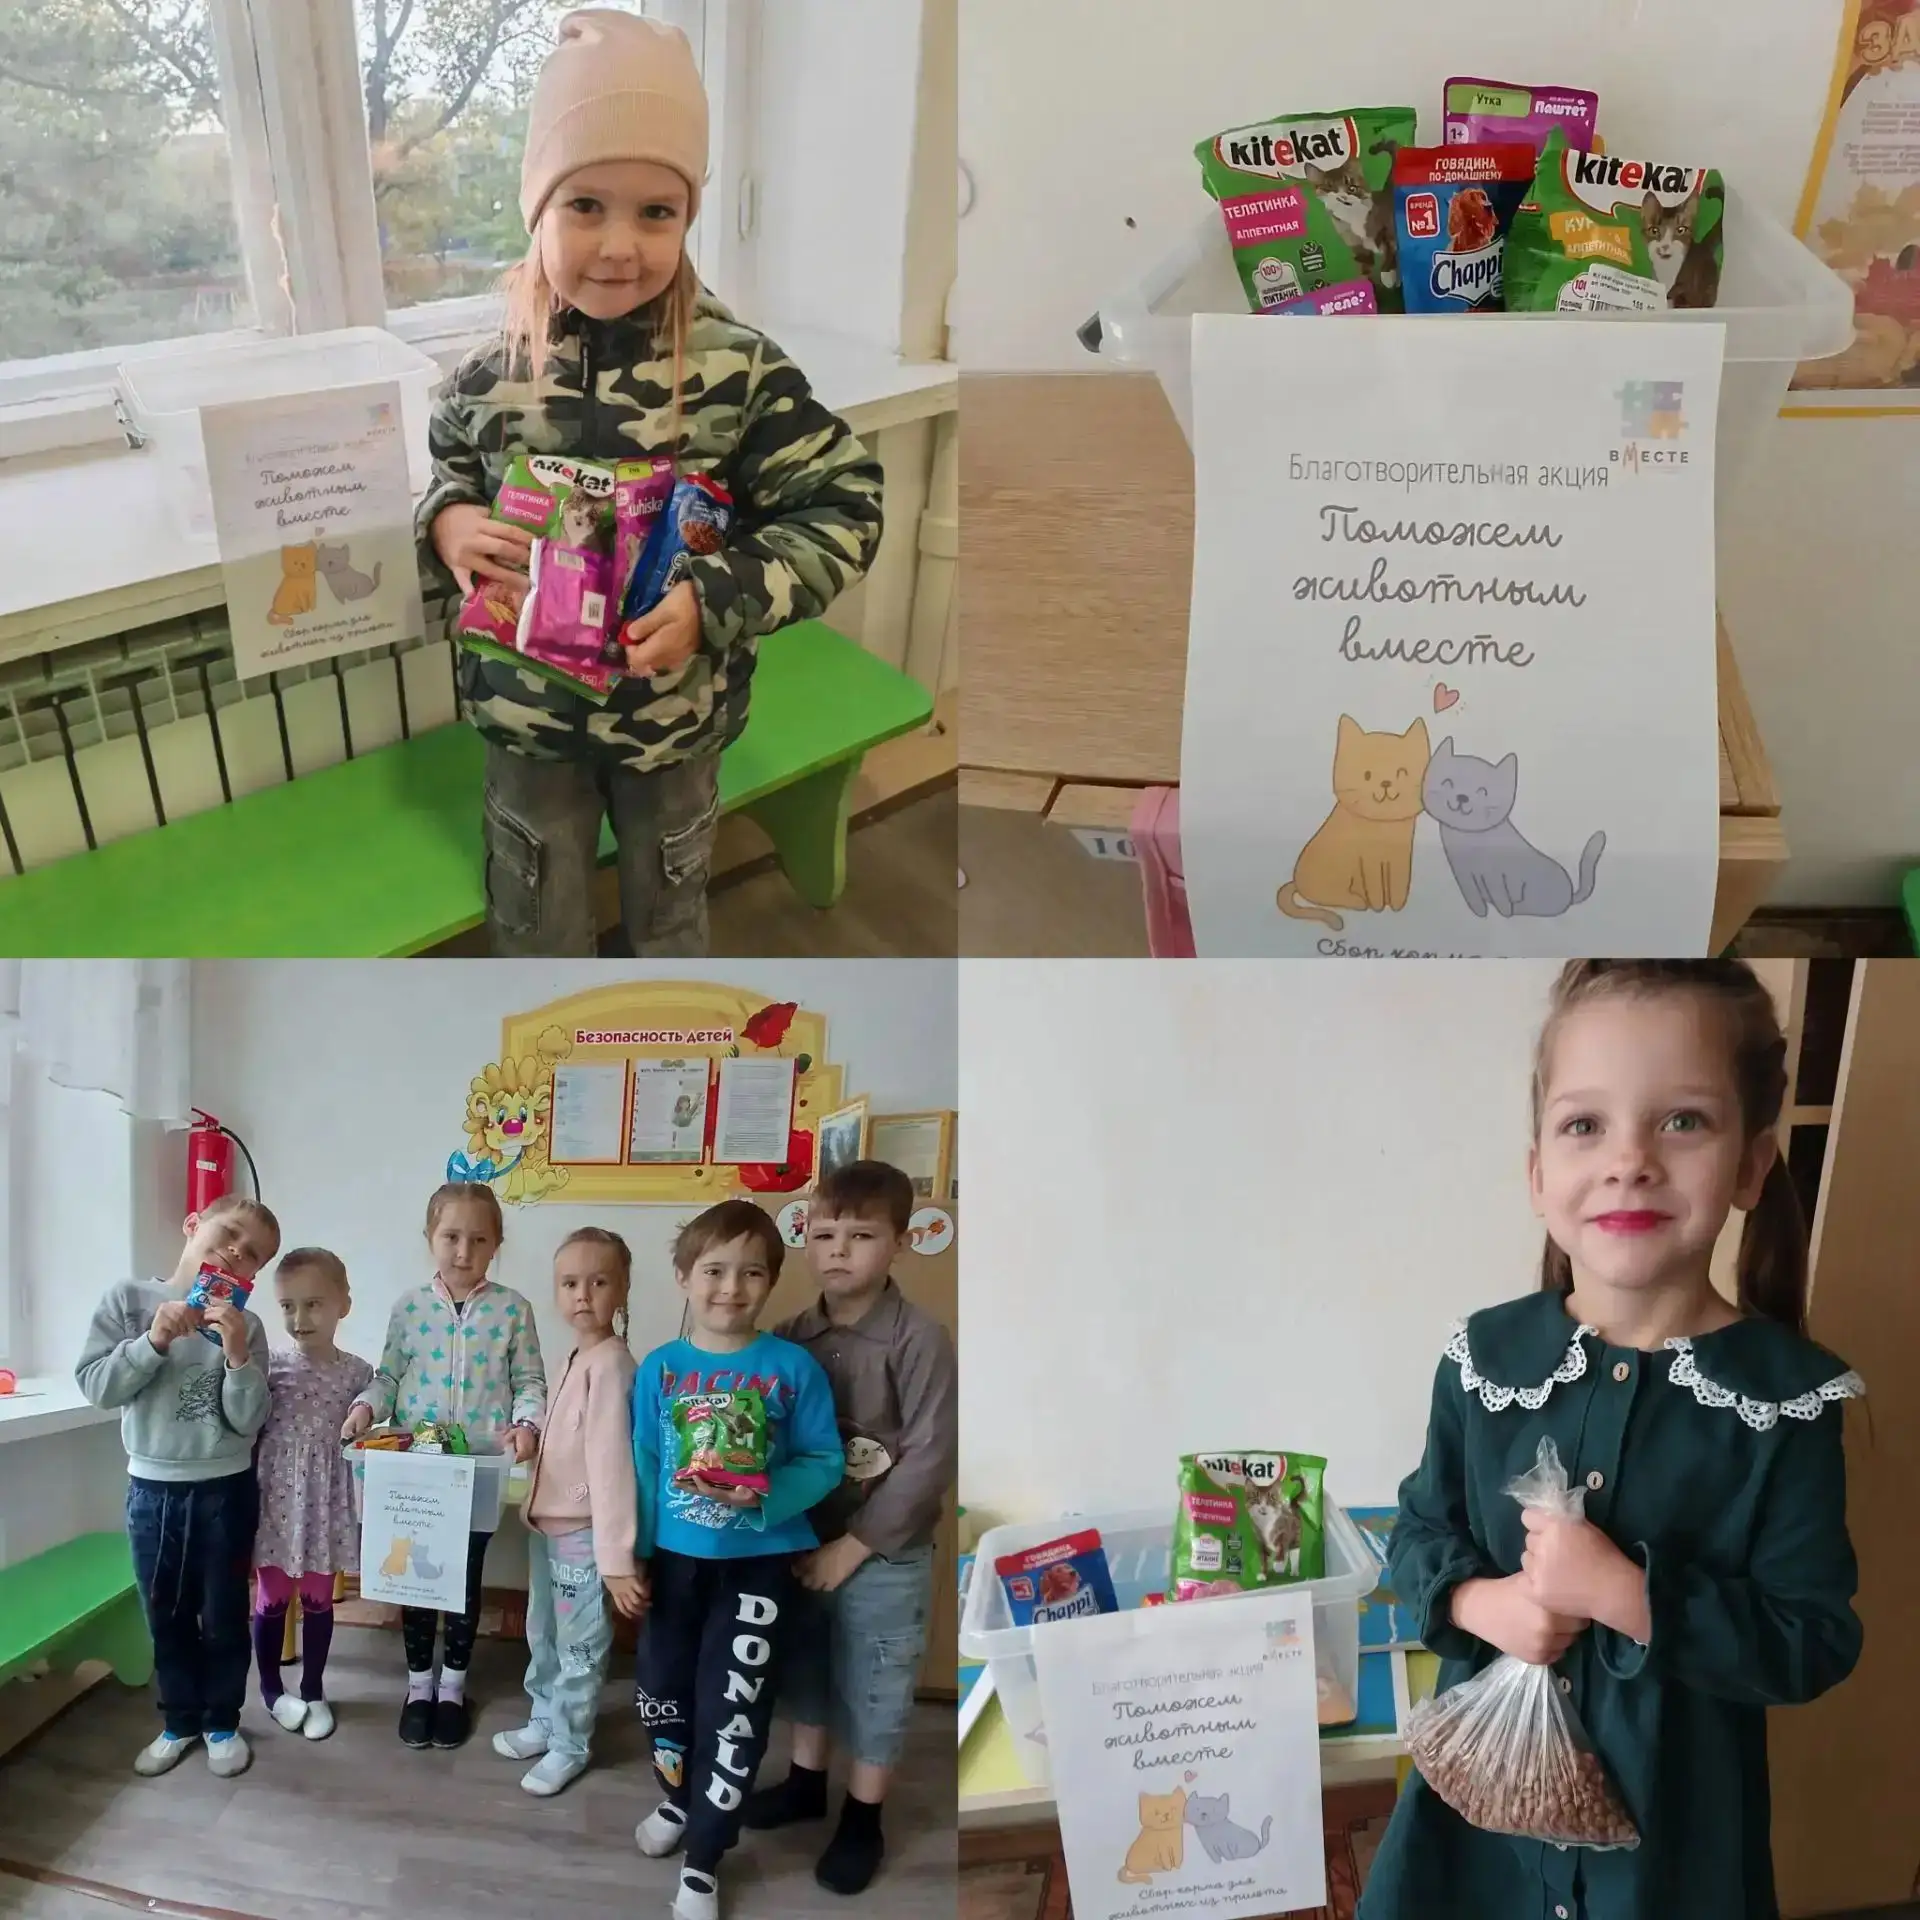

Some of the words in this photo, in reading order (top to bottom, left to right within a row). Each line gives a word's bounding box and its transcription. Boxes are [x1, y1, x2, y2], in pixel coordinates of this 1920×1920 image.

[1476, 93, 1502, 106] Утка
[1450, 127, 1464, 140] 1+
[1230, 127, 1345, 167] kitekat
[1435, 156, 1497, 171] ГОВЯДИНА
[1428, 171, 1503, 182] ПО-ДОМАШНЕМУ
[1224, 194, 1298, 219] ТЕЛЯТИНКА
[1236, 220, 1300, 240] АППЕТИТНАЯ
[1432, 247, 1503, 296] Chappi
[1263, 288, 1300, 305] ПИТАНИЕ
[260, 462, 356, 486] Поможем
[1288, 453, 1529, 493] Благотворительная
[1537, 465, 1609, 488] акция
[254, 481, 367, 510] животным
[628, 498, 664, 517] whiska
[276, 505, 351, 527] вместе
[1319, 504, 1563, 548] Поможем
[1292, 556, 1587, 607] животным
[1338, 614, 1535, 667] вместе
[576, 1030, 683, 1043] Безопасность
[686, 1028, 732, 1043] детей
[1033, 1591, 1091, 1624] Chappi
[705, 1593, 778, 1811] DONALD
[1112, 1693, 1243, 1720] Поможем
[1104, 1717, 1257, 1749] животным
[1132, 1745, 1234, 1770] вместе
